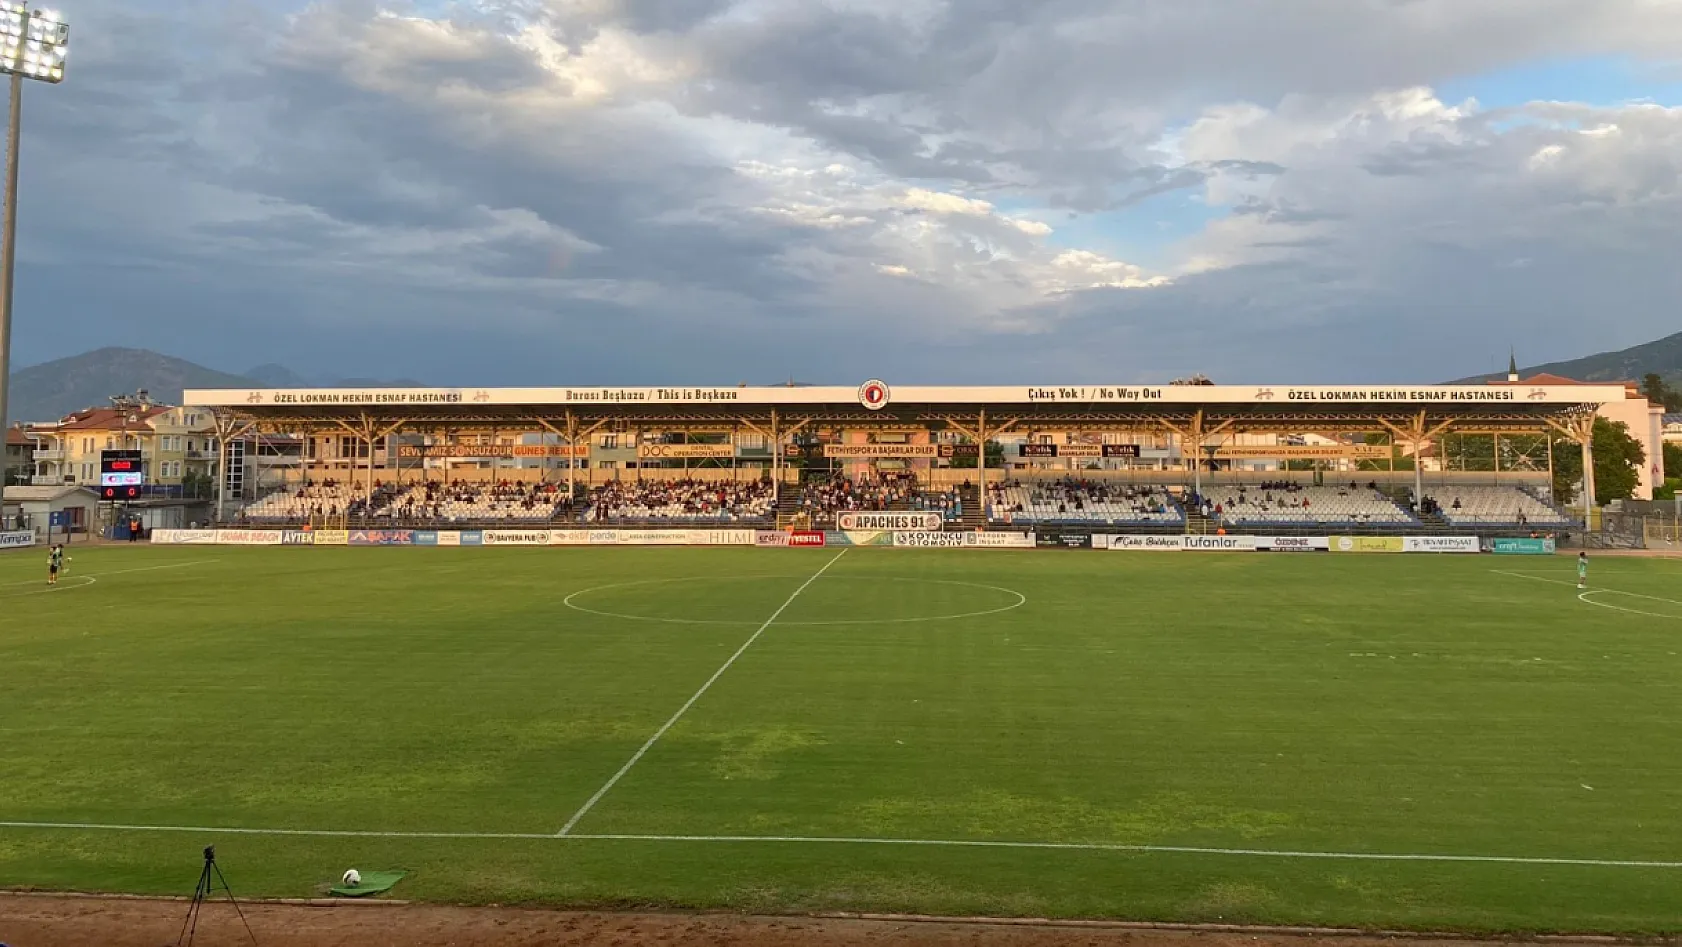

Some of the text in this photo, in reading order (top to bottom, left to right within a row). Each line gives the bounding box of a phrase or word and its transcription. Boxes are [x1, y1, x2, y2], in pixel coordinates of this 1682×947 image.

[274, 391, 463, 403] ÖZEL LOKMAN HEKİM ESNAF HASTANESİ
[566, 390, 599, 400] Burası
[603, 390, 645, 402] Beşkaza
[658, 389, 680, 400] This
[683, 389, 693, 400] is
[695, 389, 738, 402] Beşkaza
[1028, 388, 1056, 401] Çıkış
[1059, 388, 1078, 399] Yok
[1100, 388, 1114, 399] No
[1117, 388, 1140, 400] Way
[1143, 388, 1162, 399] Out
[1288, 388, 1514, 400] ÖZEL LOKMAN HEKİM ESNAF HASTANESİ
[643, 446, 671, 457] DOC
[855, 515, 925, 528] APACHES 91
[1184, 536, 1238, 548] Tufanlar
